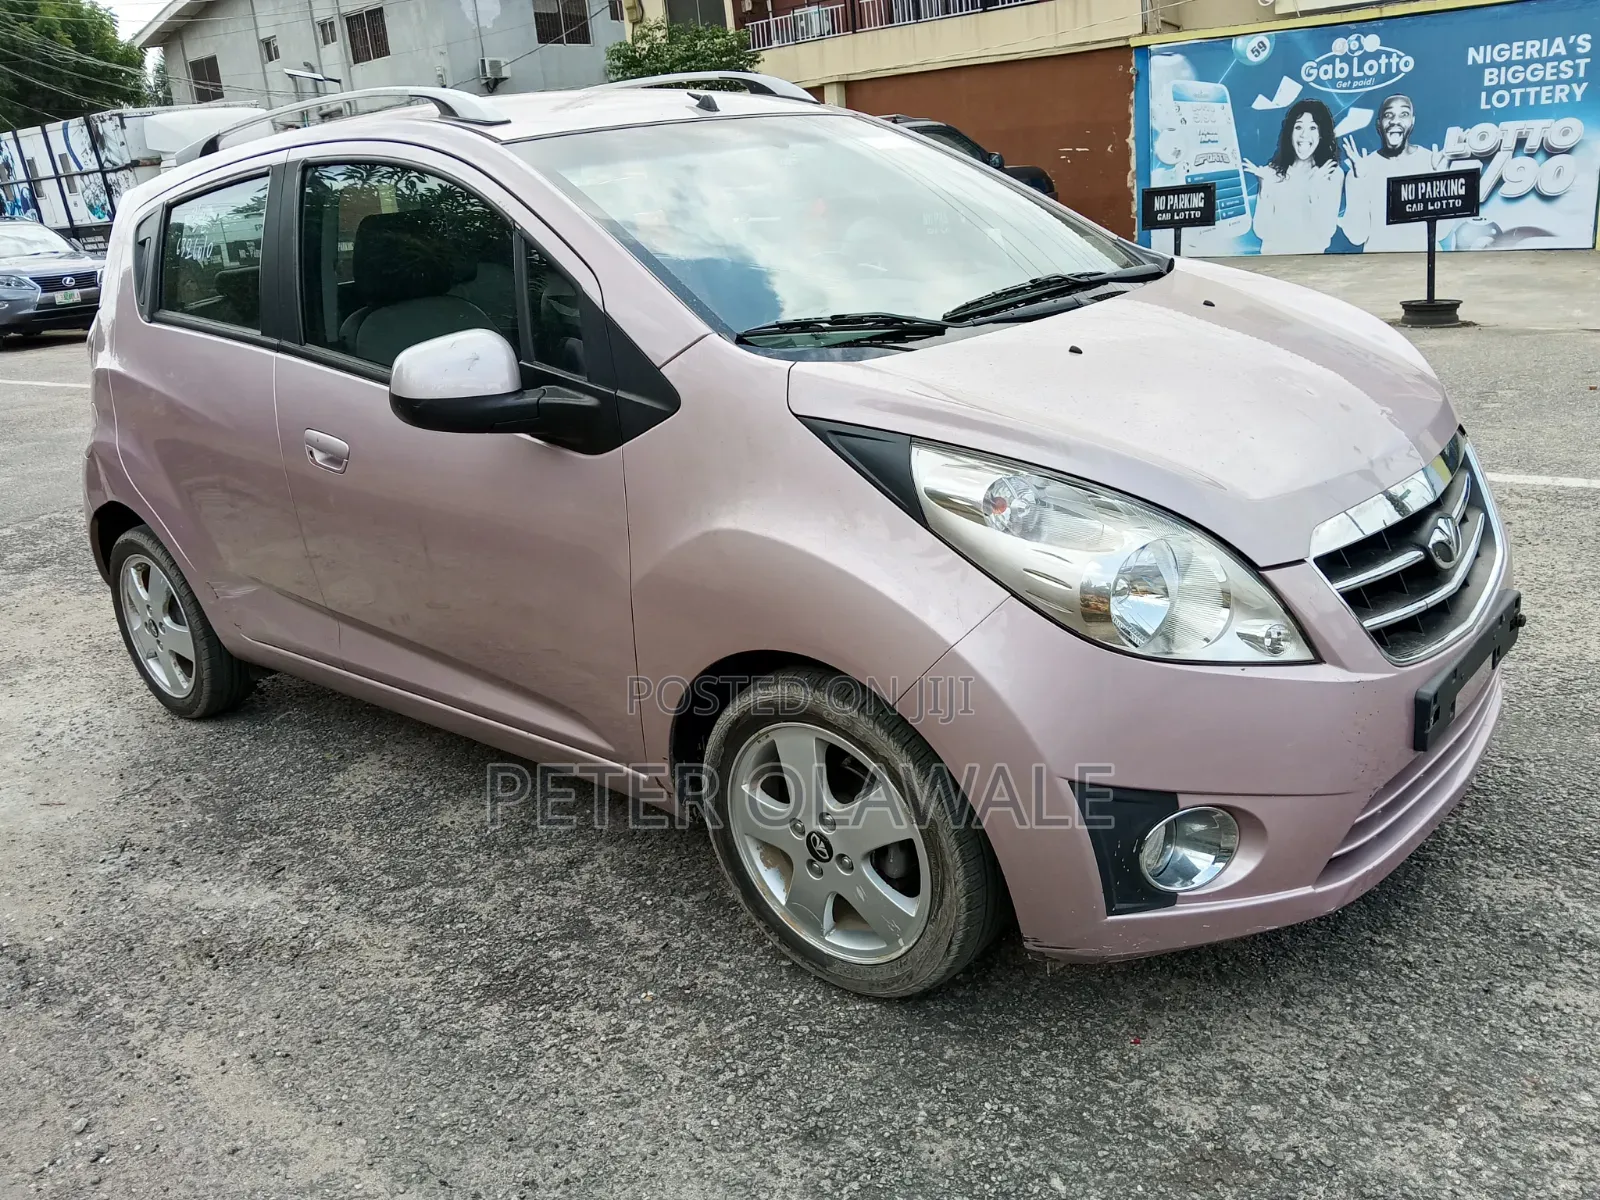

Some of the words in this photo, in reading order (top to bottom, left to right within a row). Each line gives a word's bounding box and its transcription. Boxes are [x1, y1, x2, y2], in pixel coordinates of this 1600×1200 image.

[1250, 40, 1267, 58] 59
[1467, 33, 1592, 65] NIGERIA'S
[1301, 57, 1349, 82] Gab
[1352, 52, 1415, 77] Lotto
[1483, 58, 1591, 86] BIGGEST
[1336, 80, 1351, 88] Get
[1352, 78, 1376, 88] paid!
[1480, 82, 1588, 109] LOTTERY
[1443, 117, 1584, 159] LOTTO
[1401, 183, 1416, 201] NO
[1418, 178, 1466, 199] PARKING
[1154, 195, 1166, 211] NO
[1167, 192, 1205, 210] PARKING
[1405, 203, 1424, 212] GAB
[1428, 199, 1462, 210] LOTTO
[1174, 210, 1201, 219] LOTTO
